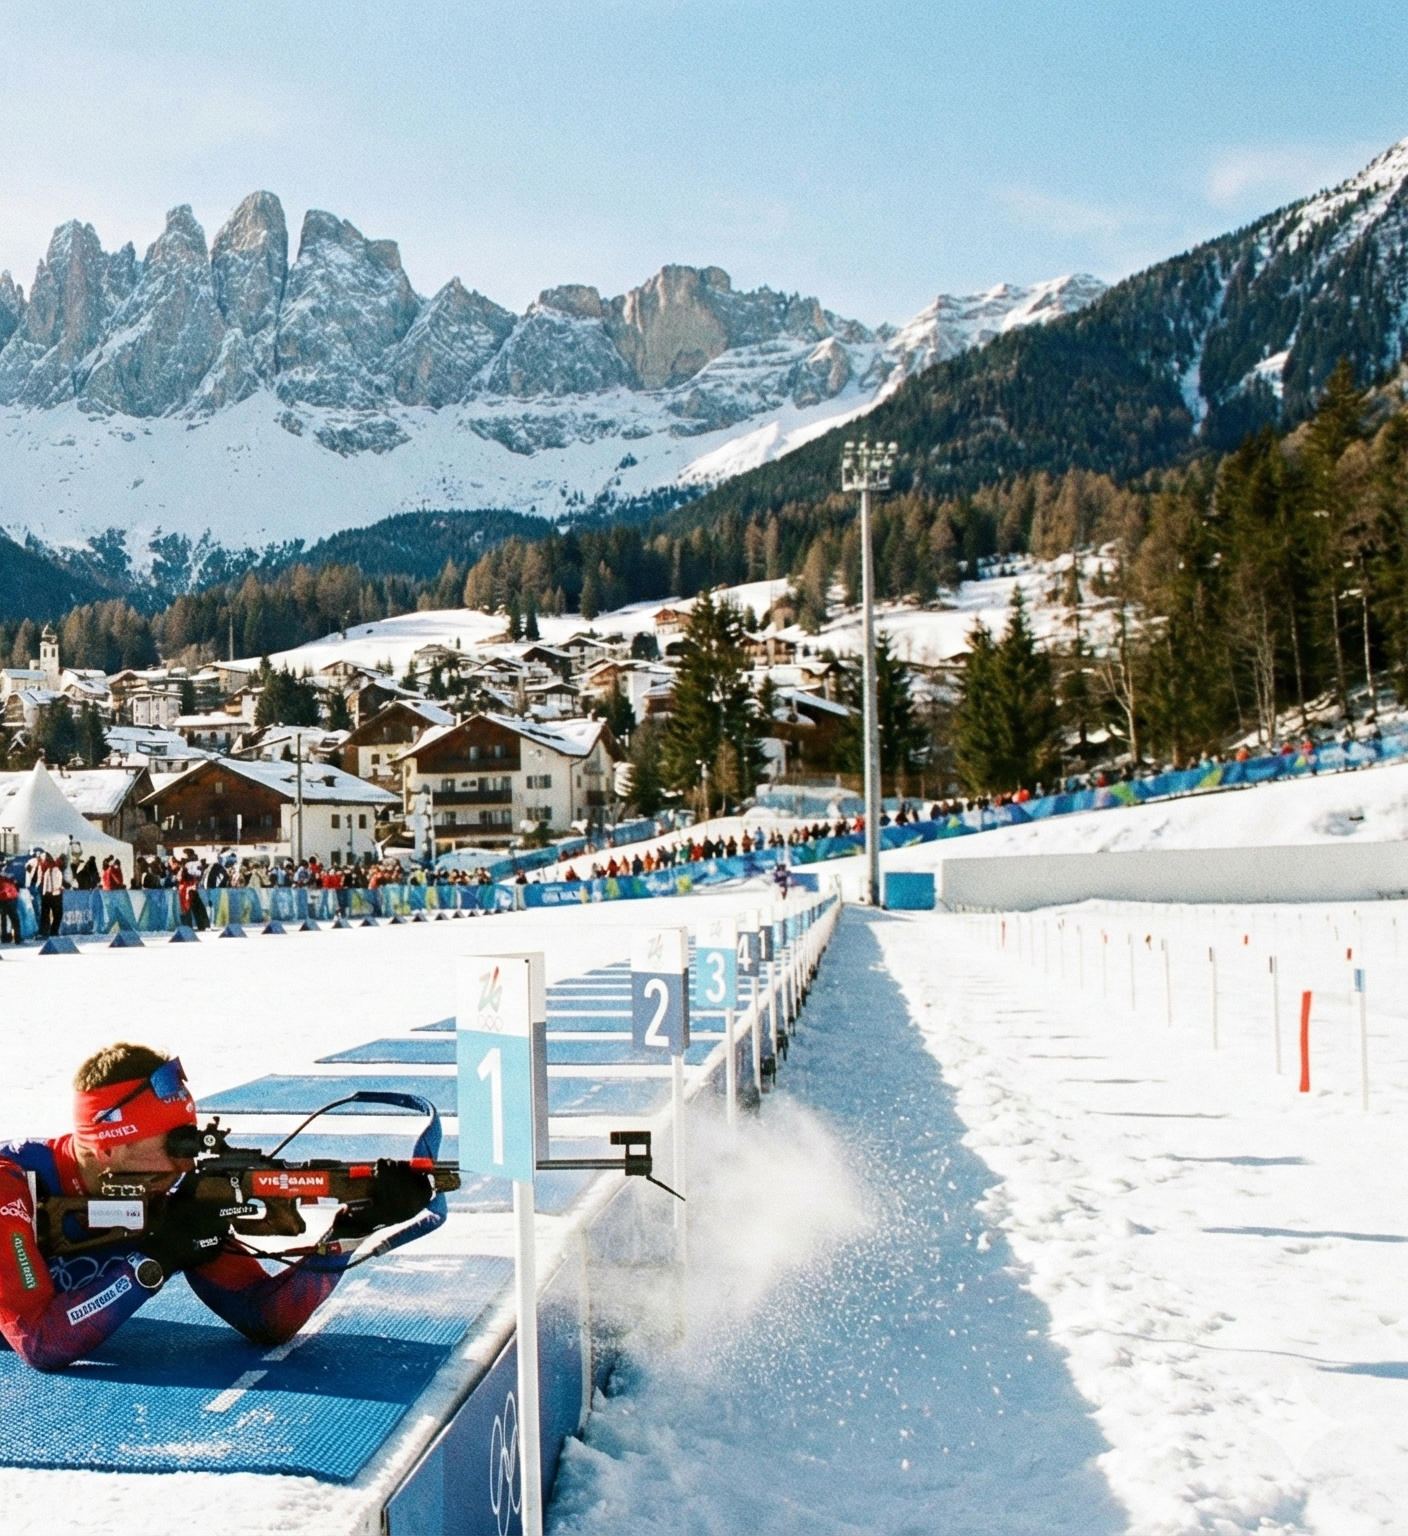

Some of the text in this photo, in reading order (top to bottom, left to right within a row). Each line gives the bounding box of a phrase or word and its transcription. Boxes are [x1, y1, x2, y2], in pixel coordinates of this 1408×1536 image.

[705, 951, 727, 1003] 3
[737, 933, 752, 972] 4
[644, 978, 670, 1047] 2
[476, 1047, 504, 1166] 1
